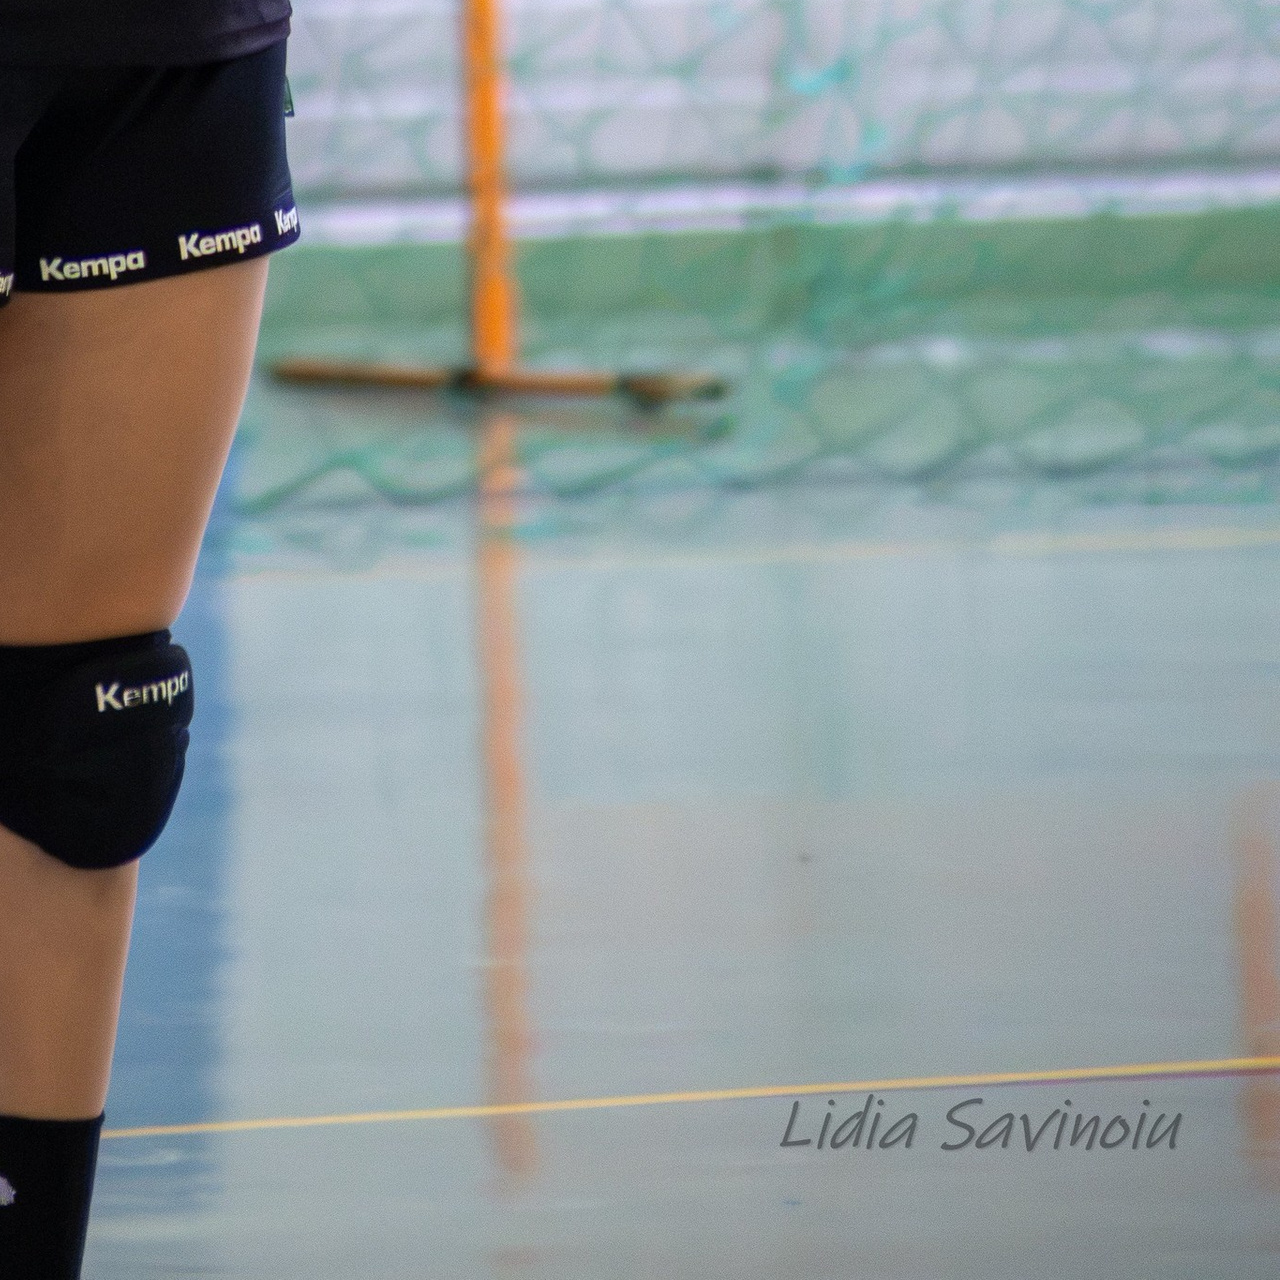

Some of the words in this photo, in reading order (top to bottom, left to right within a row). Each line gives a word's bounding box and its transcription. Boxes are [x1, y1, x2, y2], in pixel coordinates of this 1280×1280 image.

[39, 250, 147, 282] Kempa
[178, 222, 262, 261] Kempa
[95, 670, 189, 713] Kempa
